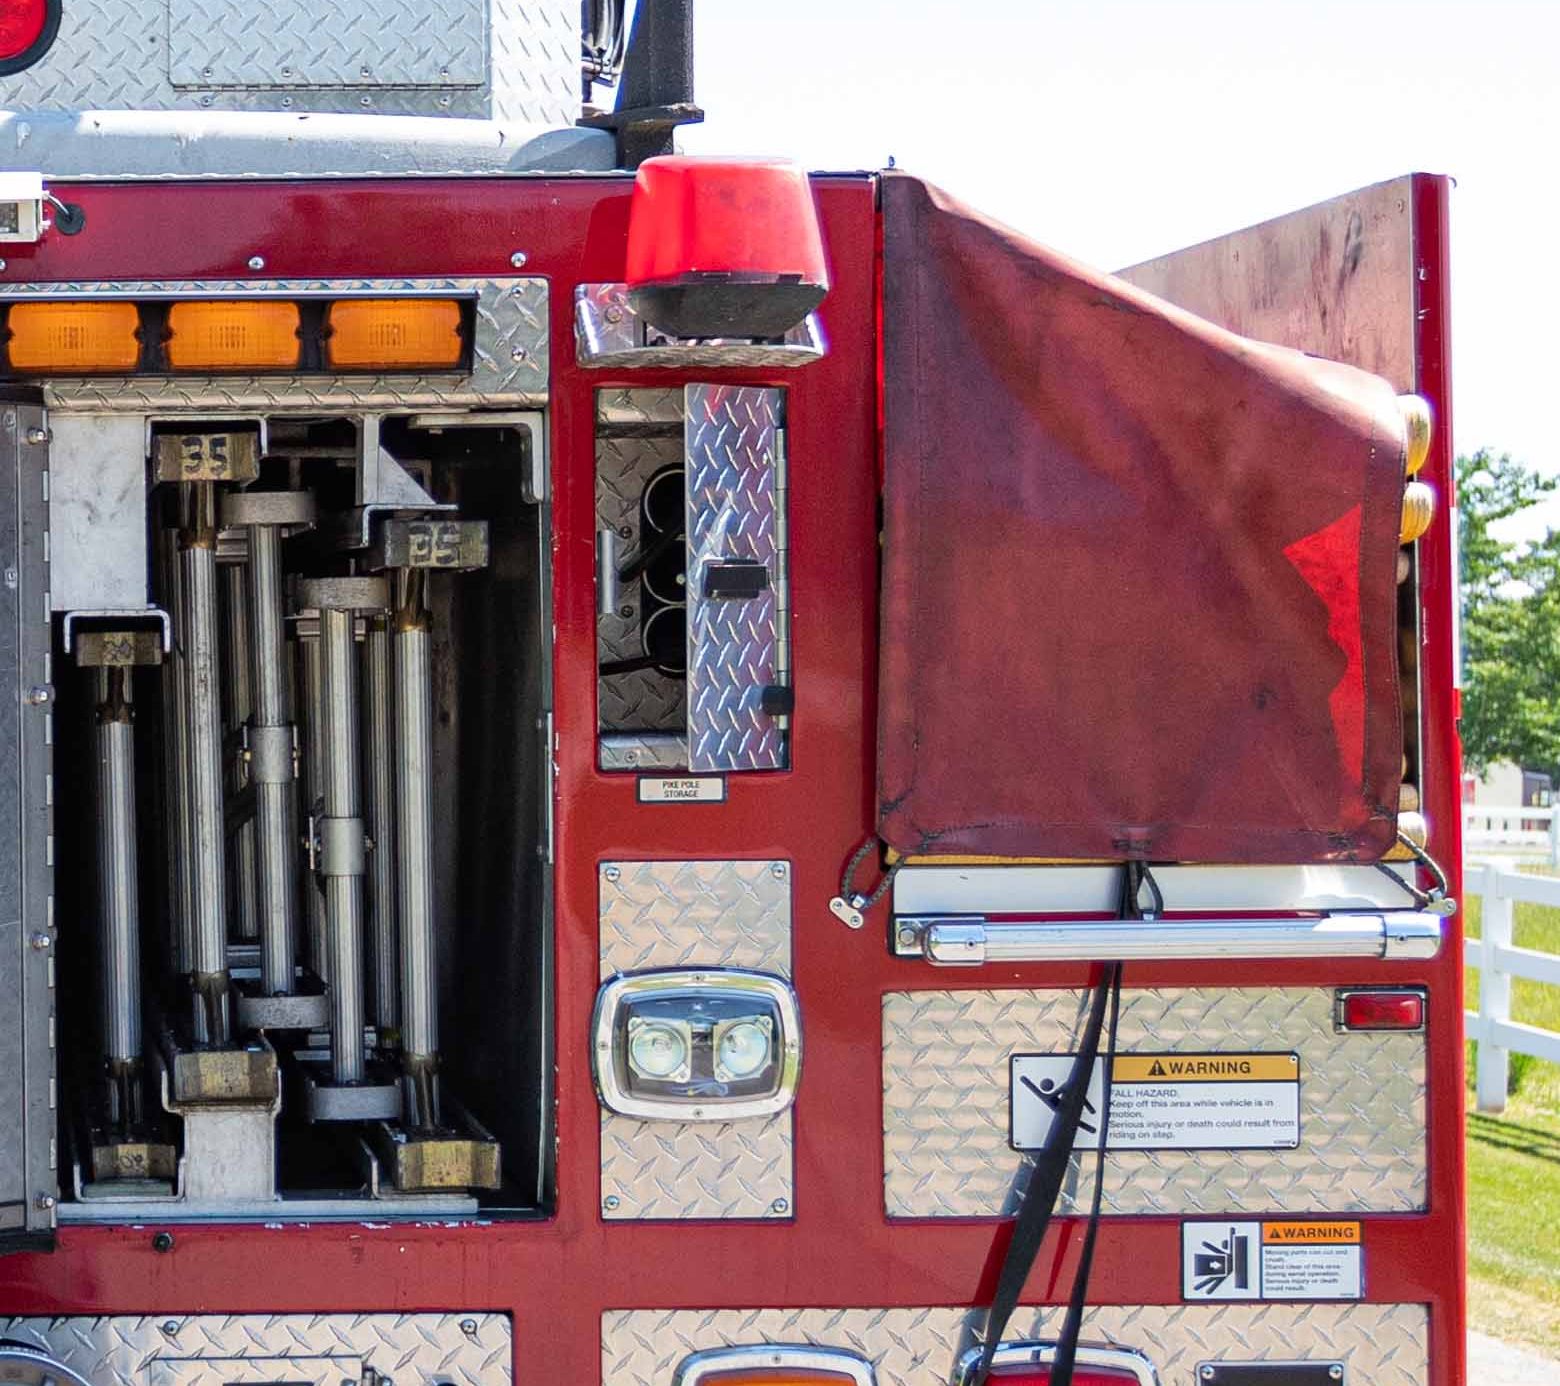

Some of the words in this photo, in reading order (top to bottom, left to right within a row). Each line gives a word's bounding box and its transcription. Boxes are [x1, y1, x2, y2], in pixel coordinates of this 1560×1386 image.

[662, 780, 678, 789] PIKE
[681, 780, 700, 789] POLE
[664, 790, 698, 798] STORAGE
[1169, 1061, 1251, 1074] WARNING
[1147, 1121, 1172, 1129] injury
[1109, 1132, 1136, 1140] riding
[1152, 1132, 1175, 1140] step.
[1284, 1228, 1354, 1238] WARNING
